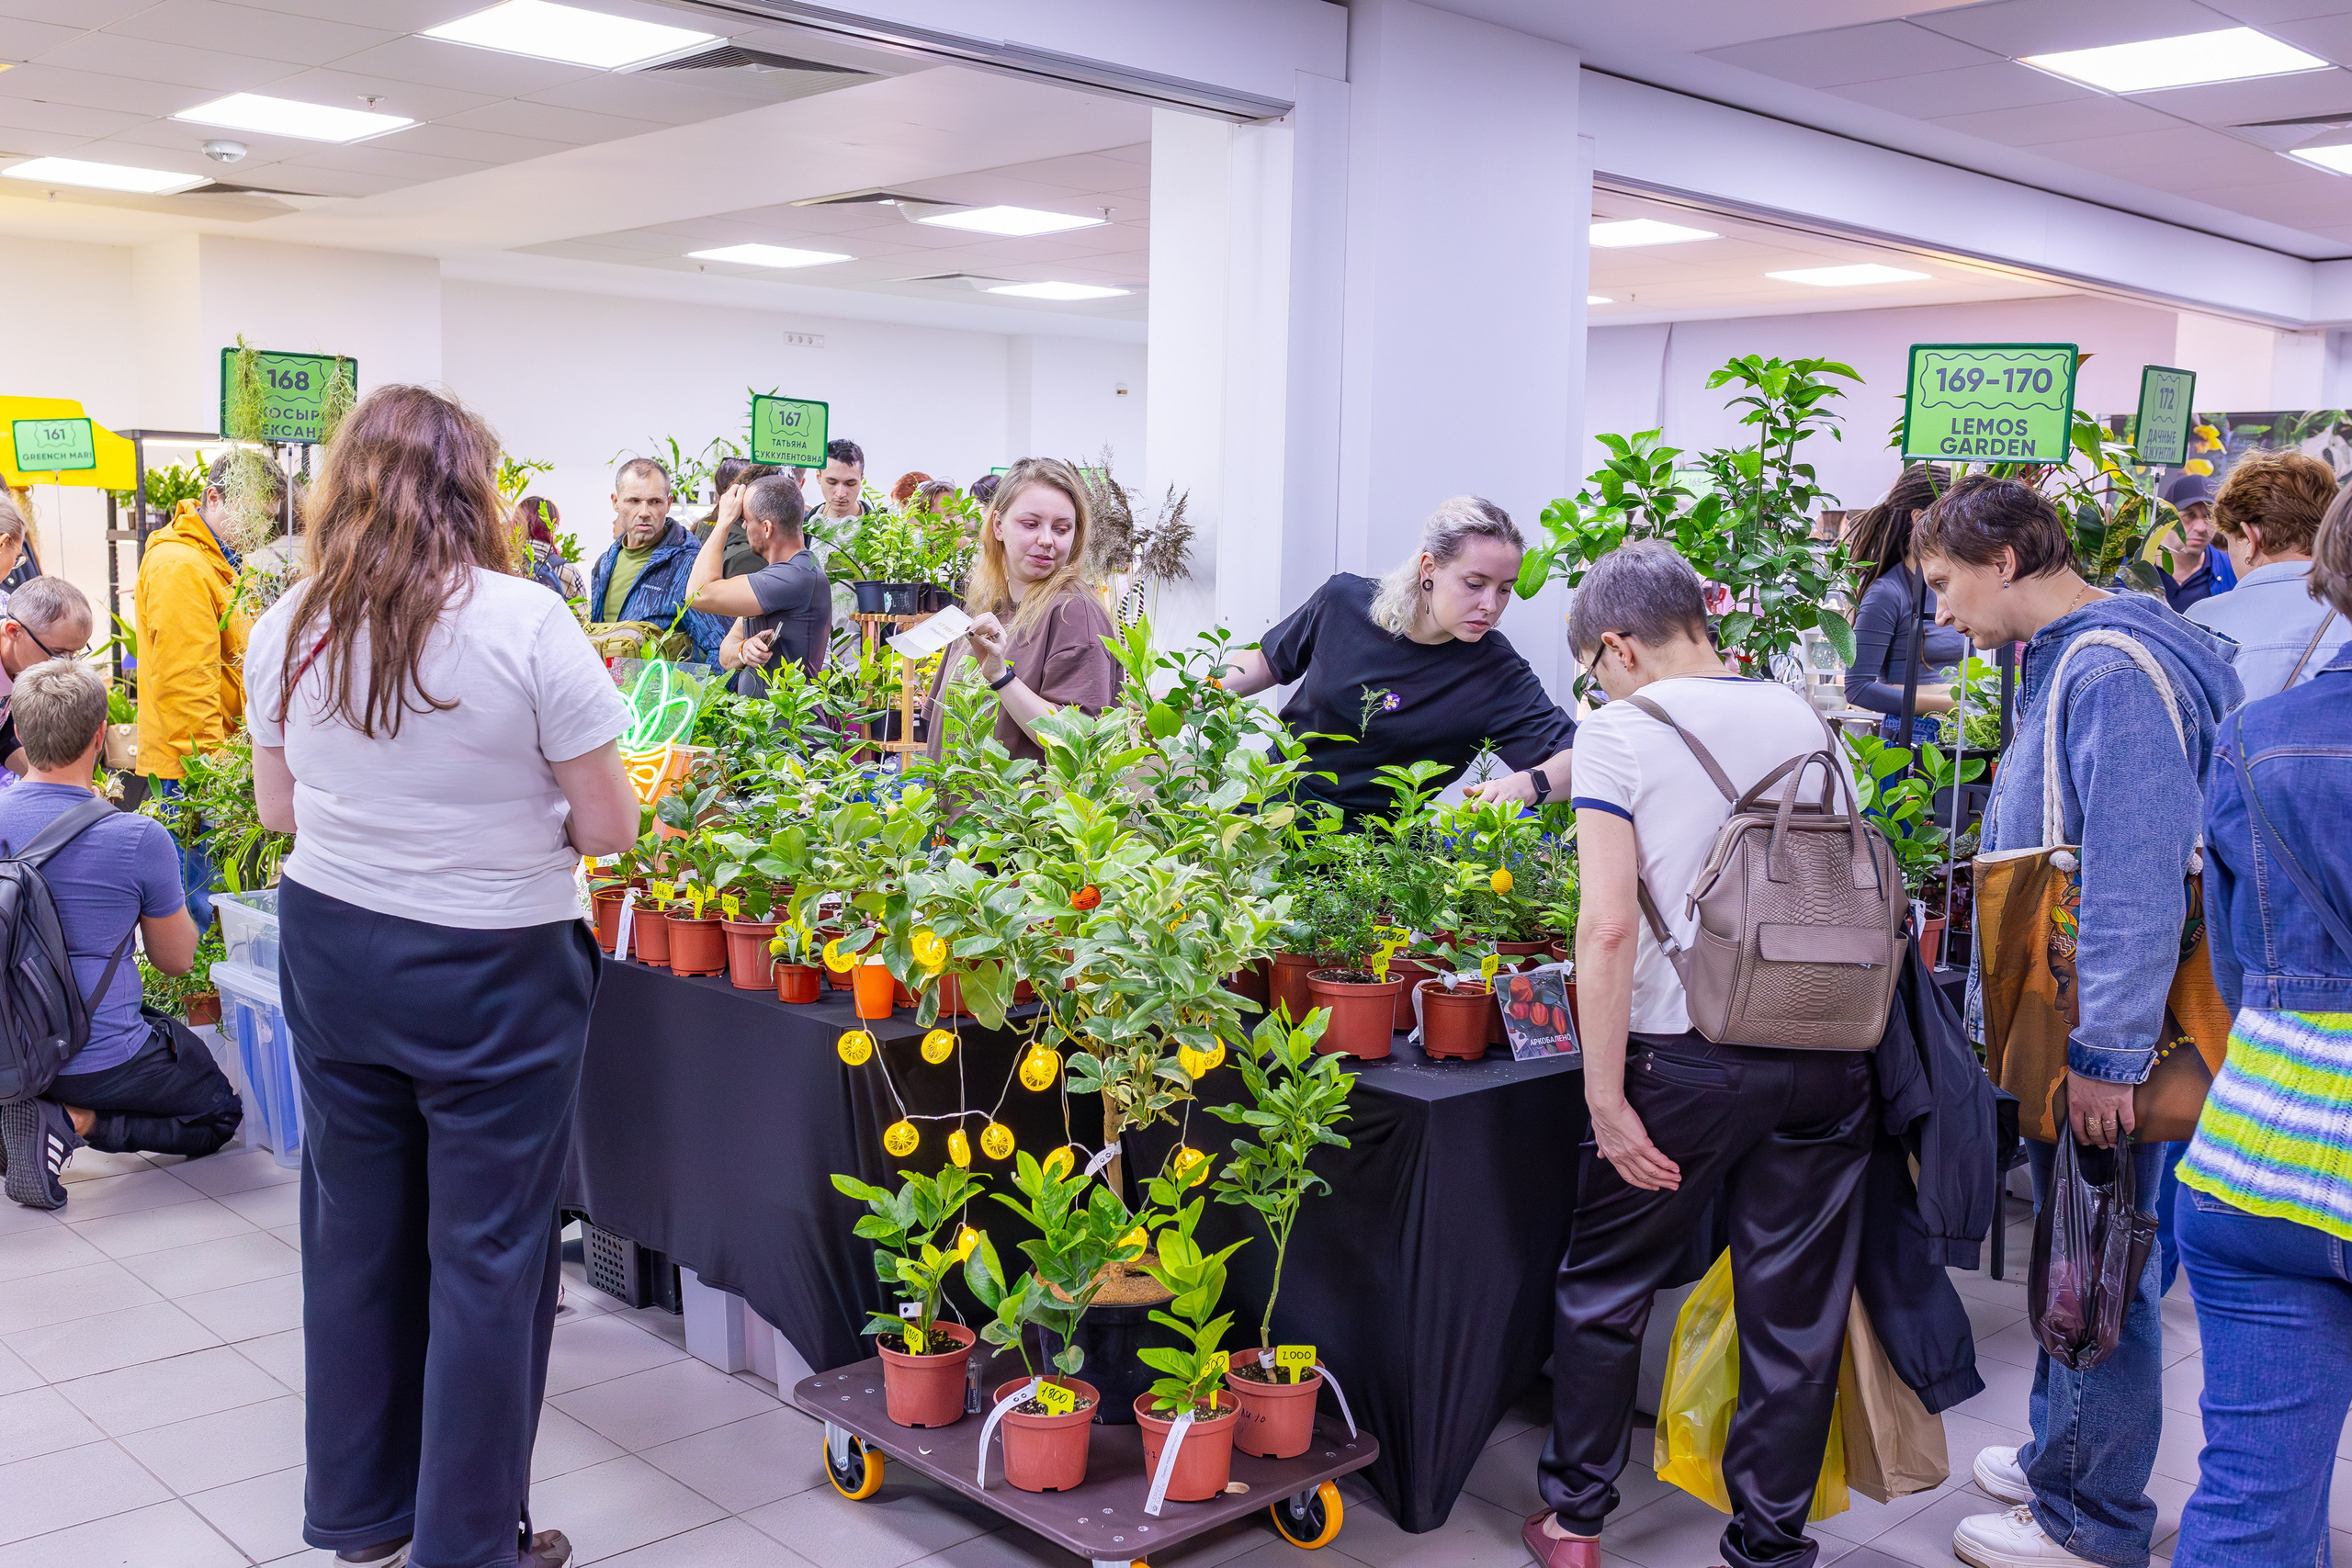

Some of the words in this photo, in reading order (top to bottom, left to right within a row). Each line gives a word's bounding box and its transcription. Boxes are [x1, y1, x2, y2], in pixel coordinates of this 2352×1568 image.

[266, 368, 310, 391] 168
[1936, 367, 2052, 393] 169-170
[2159, 387, 2175, 410] 172
[778, 410, 801, 427] 167
[1951, 417, 2028, 436] LEMOS
[44, 429, 65, 440] 161
[2146, 428, 2177, 445] ДАЧНЫЕ
[772, 438, 807, 449] ТАТЬЯНА
[1940, 436, 2036, 457] GARDEN
[22, 452, 67, 461] GREENCH
[754, 450, 822, 463] СУККУЛЕНТОВНА
[2143, 445, 2177, 461] ДЖУНГЛИ
[1530, 1033, 1572, 1046] АРКОБАЛЕНО
[1204, 1355, 1226, 1371] 500
[1283, 1350, 1312, 1360] 2000
[1041, 1386, 1069, 1404] 1800
